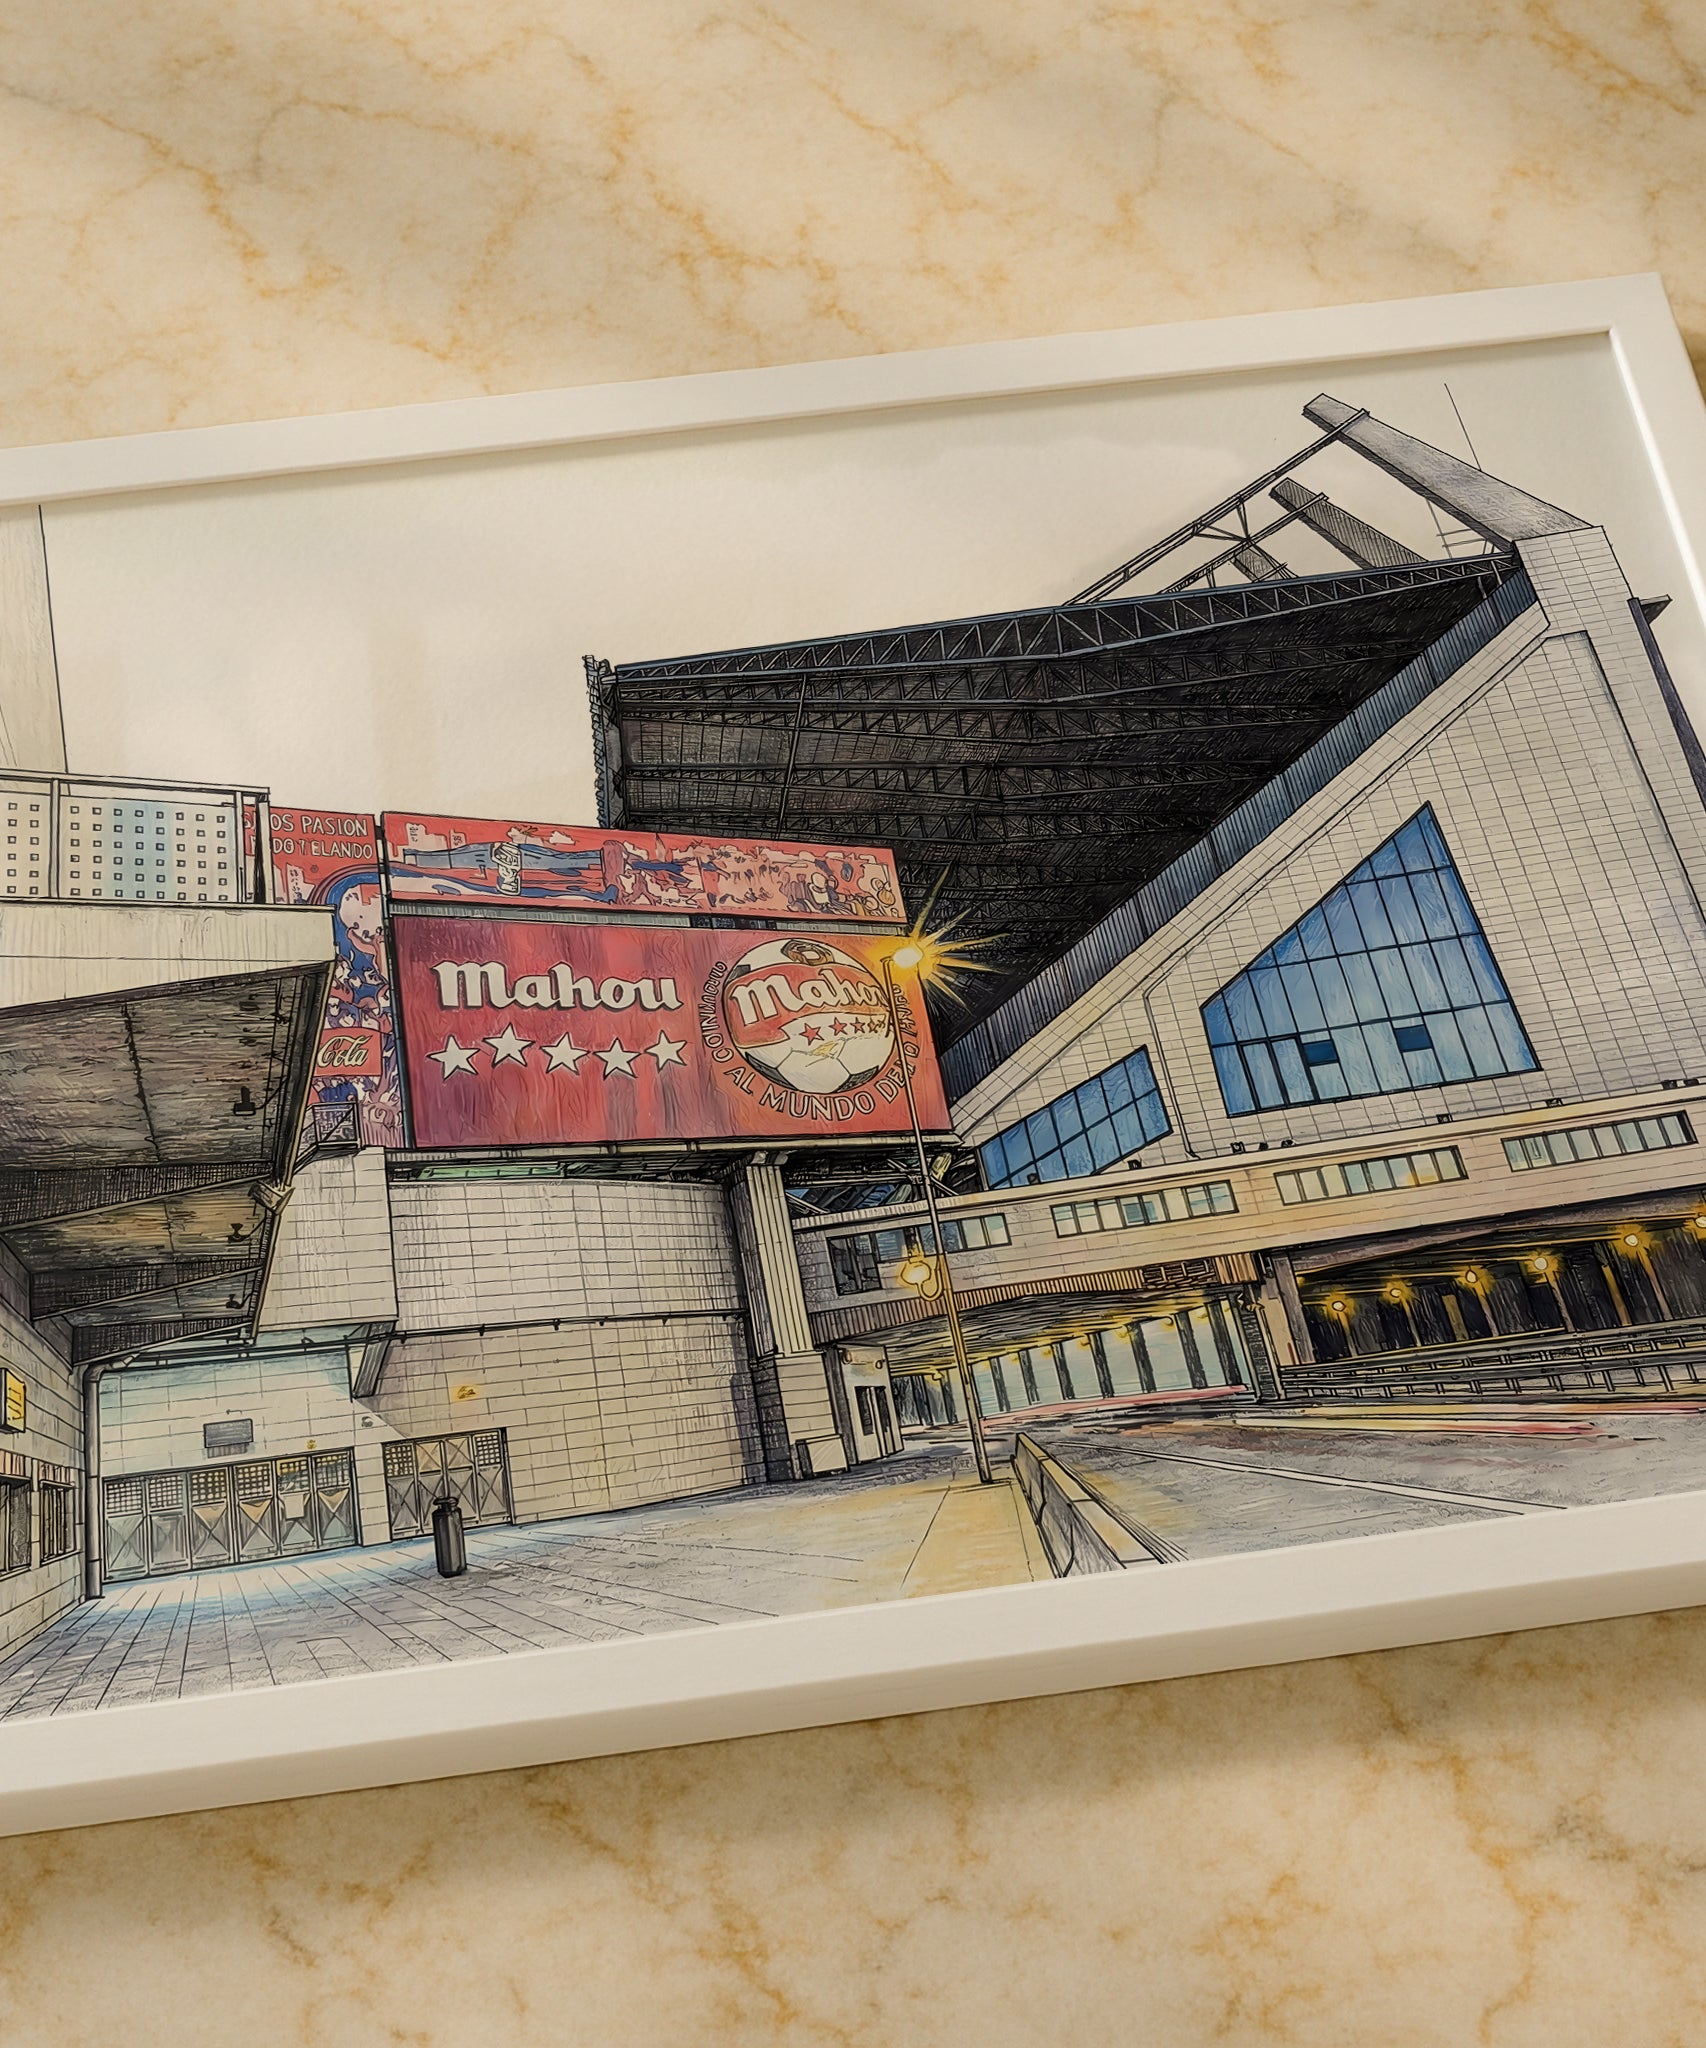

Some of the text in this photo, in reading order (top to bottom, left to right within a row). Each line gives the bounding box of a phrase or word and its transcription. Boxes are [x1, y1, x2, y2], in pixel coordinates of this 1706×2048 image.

[301, 814, 368, 837] PASION
[431, 960, 684, 1012] Mahou
[317, 1034, 373, 1068] Cola
[723, 1066, 756, 1096] AL
[759, 1084, 875, 1121] MUNDO
